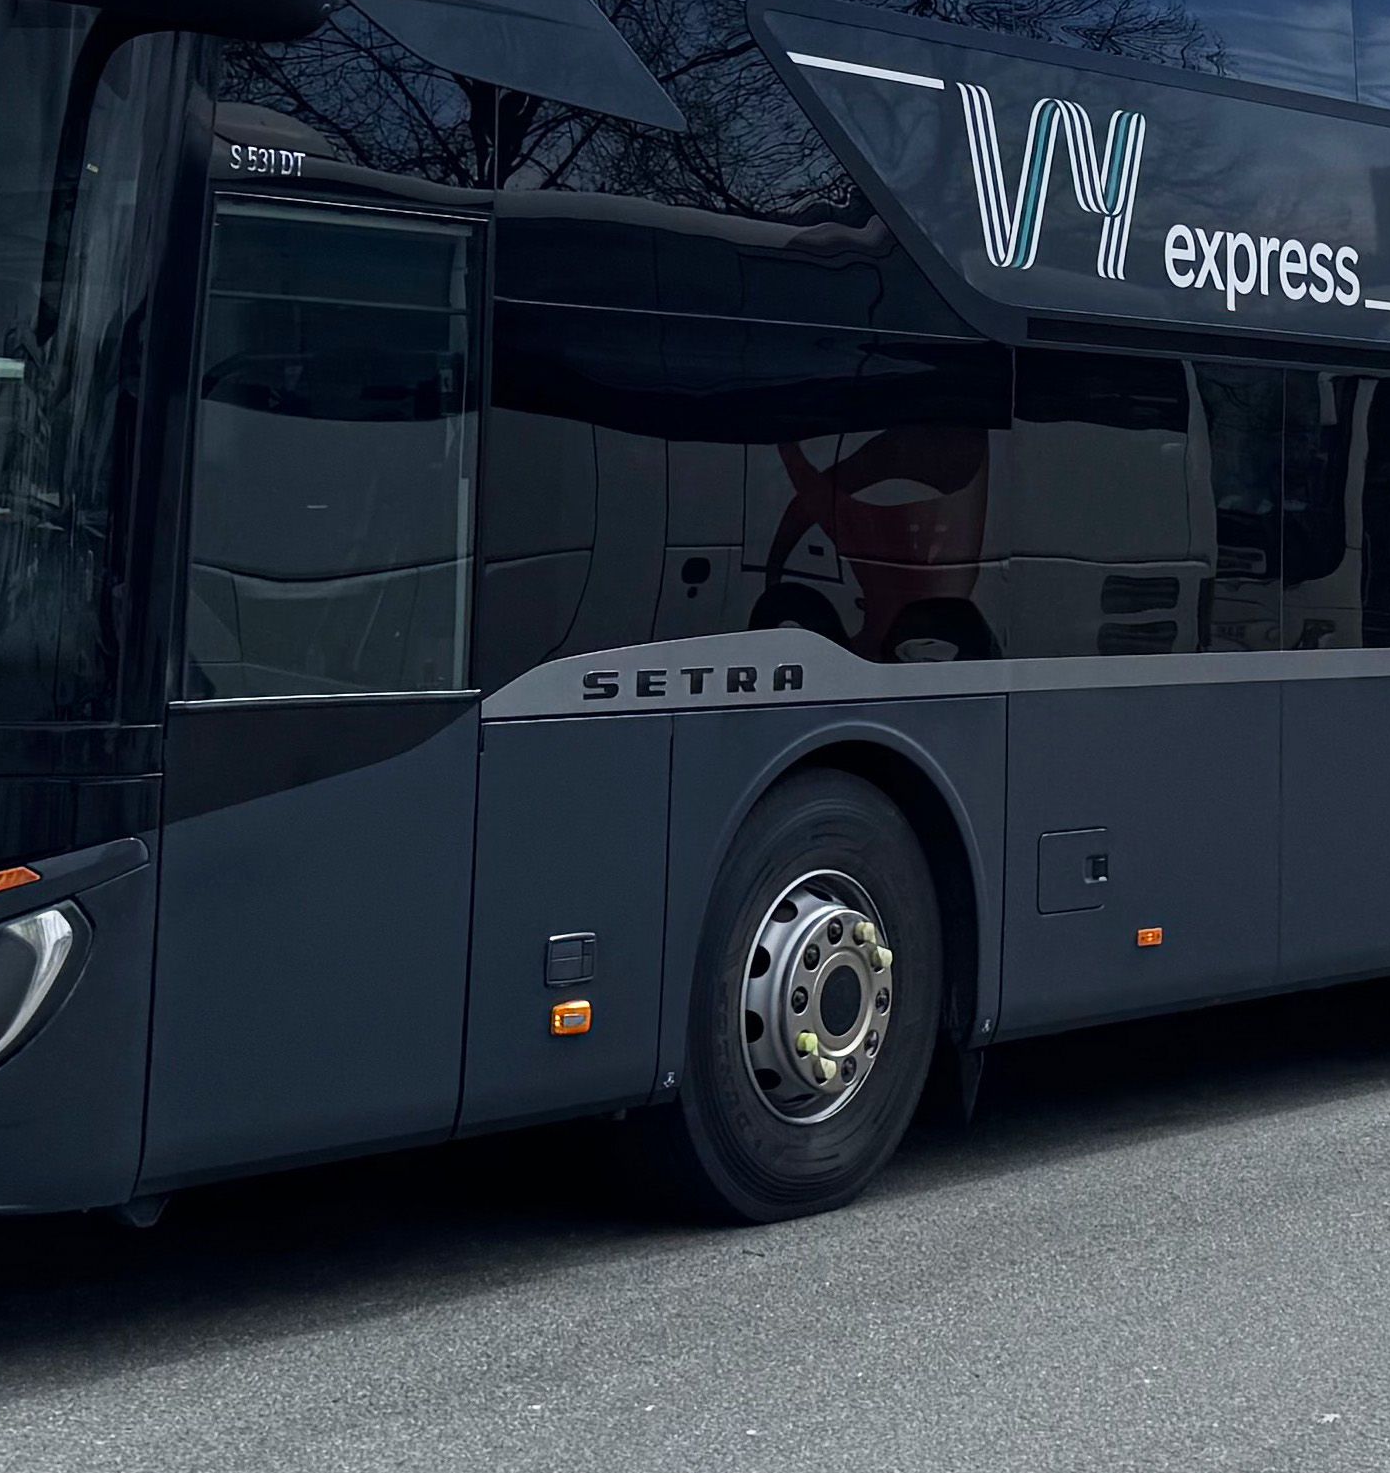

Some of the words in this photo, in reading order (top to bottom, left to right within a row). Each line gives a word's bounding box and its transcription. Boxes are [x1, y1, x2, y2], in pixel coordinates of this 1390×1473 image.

[230, 145, 242, 169] S
[247, 146, 275, 174] 531
[279, 150, 306, 177] DT
[1164, 223, 1361, 312] express
[582, 664, 804, 700] SETRA
